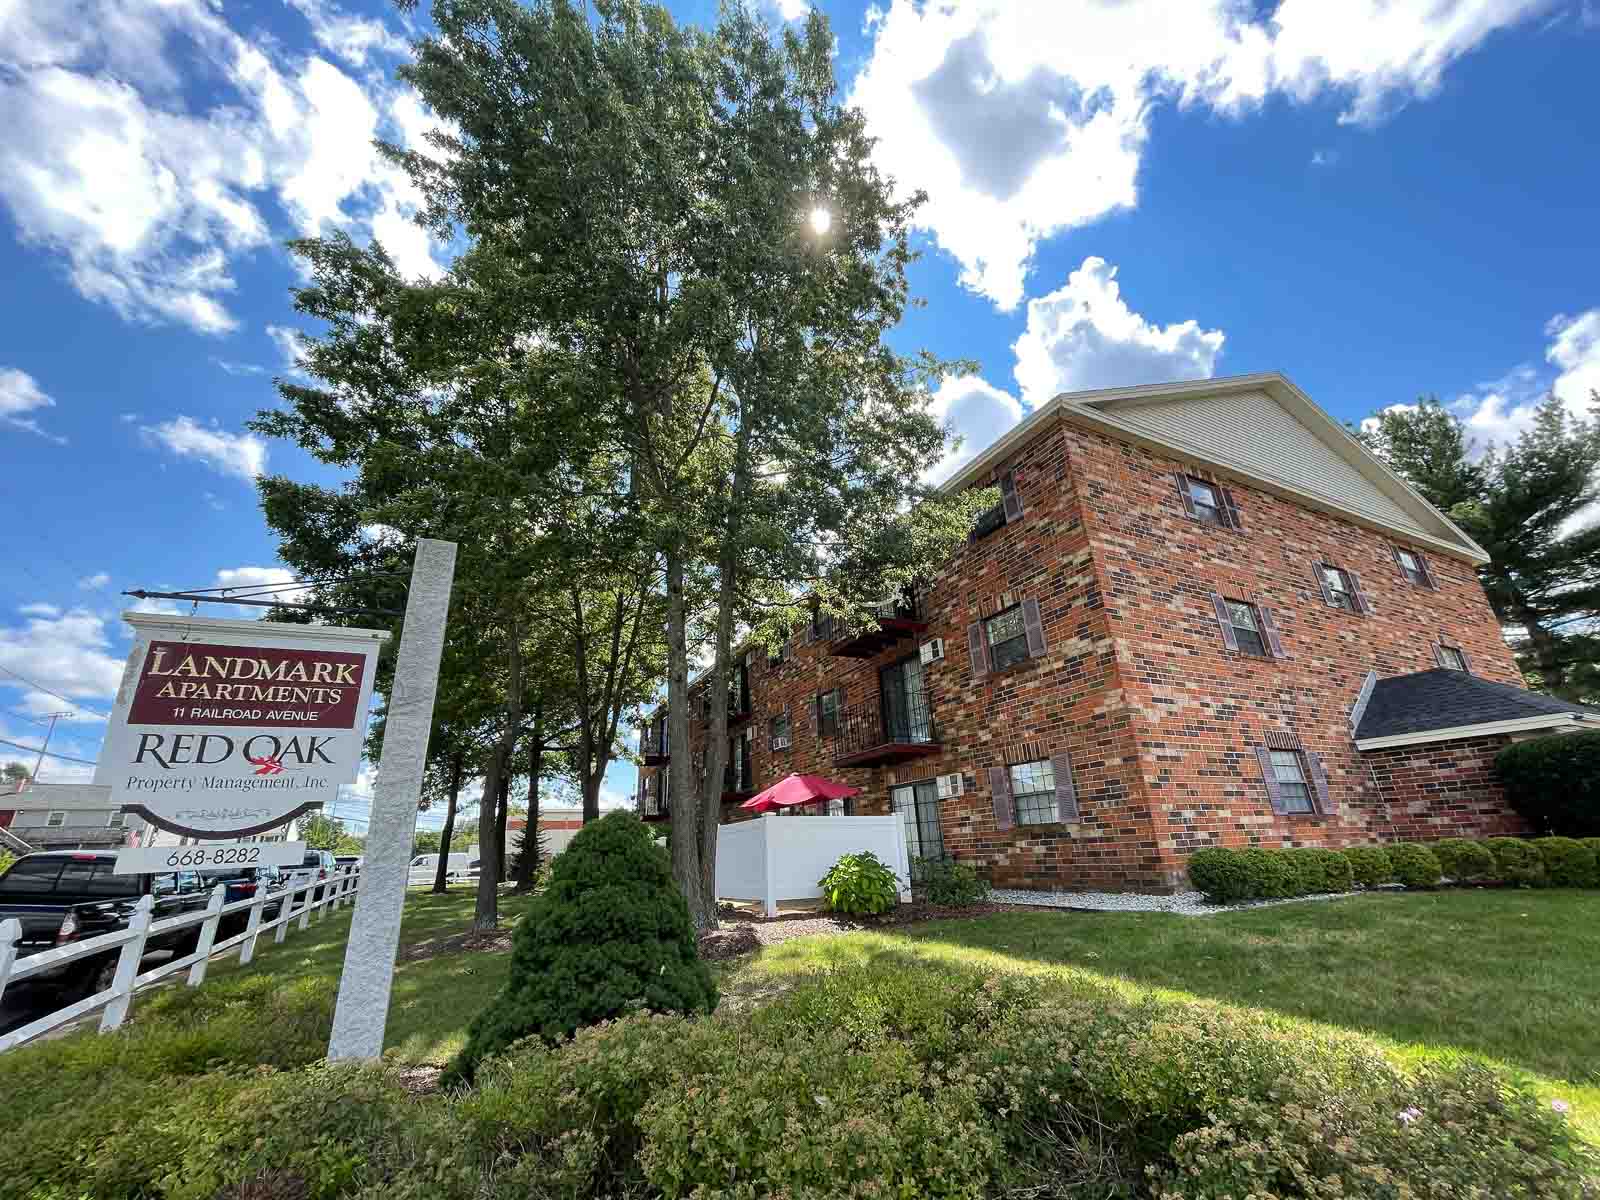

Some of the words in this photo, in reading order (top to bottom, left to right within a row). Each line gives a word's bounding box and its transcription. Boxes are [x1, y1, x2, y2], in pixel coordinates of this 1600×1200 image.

[147, 649, 359, 685] LANDMARK
[156, 682, 342, 705] APARTMENTS
[173, 707, 185, 719] 11
[190, 708, 262, 720] RAILROAD
[266, 710, 319, 721] AVENUE
[131, 733, 235, 769] RED
[242, 734, 337, 765] OAK
[126, 776, 195, 793] Property
[166, 847, 260, 866] 668-8282
